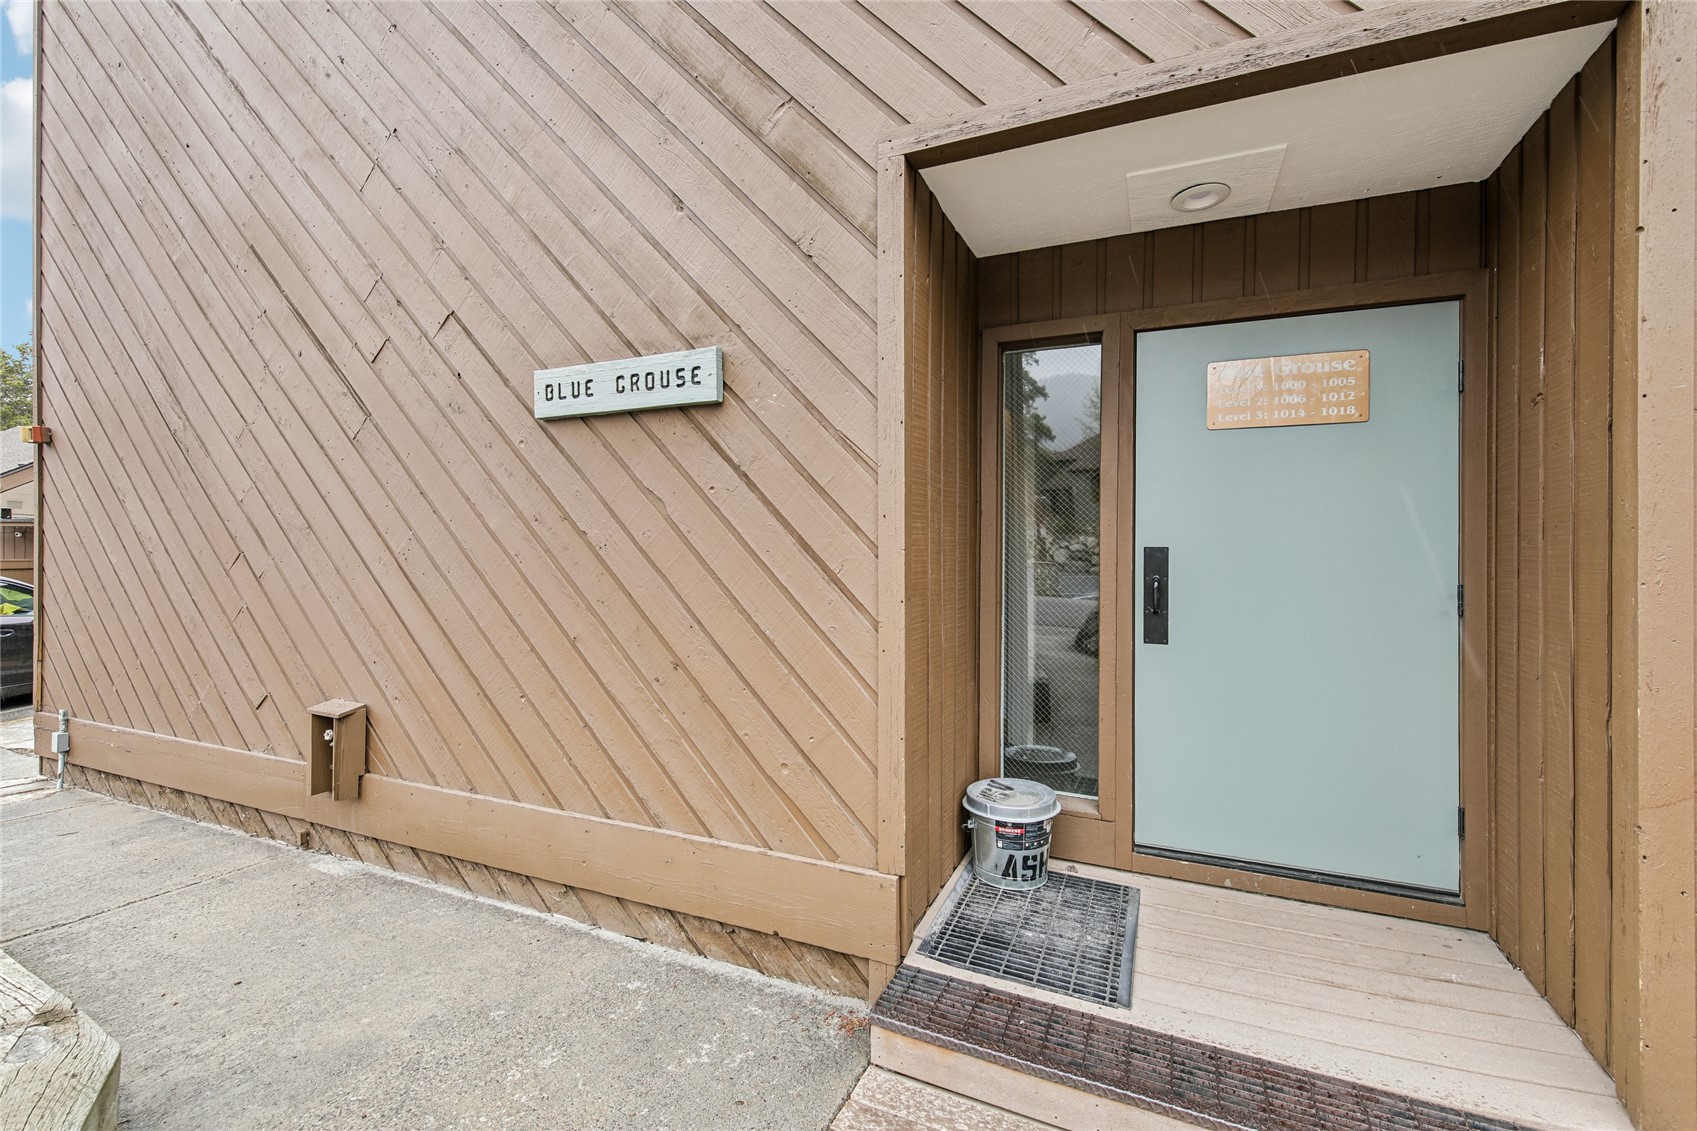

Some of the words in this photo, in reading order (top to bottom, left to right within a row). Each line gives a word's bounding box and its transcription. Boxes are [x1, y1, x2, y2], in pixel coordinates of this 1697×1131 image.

[1273, 359, 1357, 376] Grouse
[545, 378, 594, 402] BLUE
[615, 365, 702, 394] GROUSE
[1322, 376, 1356, 387] 1005
[1217, 397, 1251, 409] Level
[1255, 397, 1268, 406] 2:
[1273, 394, 1307, 405] 1006
[1322, 391, 1356, 402] 1012
[1217, 411, 1251, 422] Level
[1273, 407, 1307, 419] 1014
[1322, 405, 1356, 416] 1018
